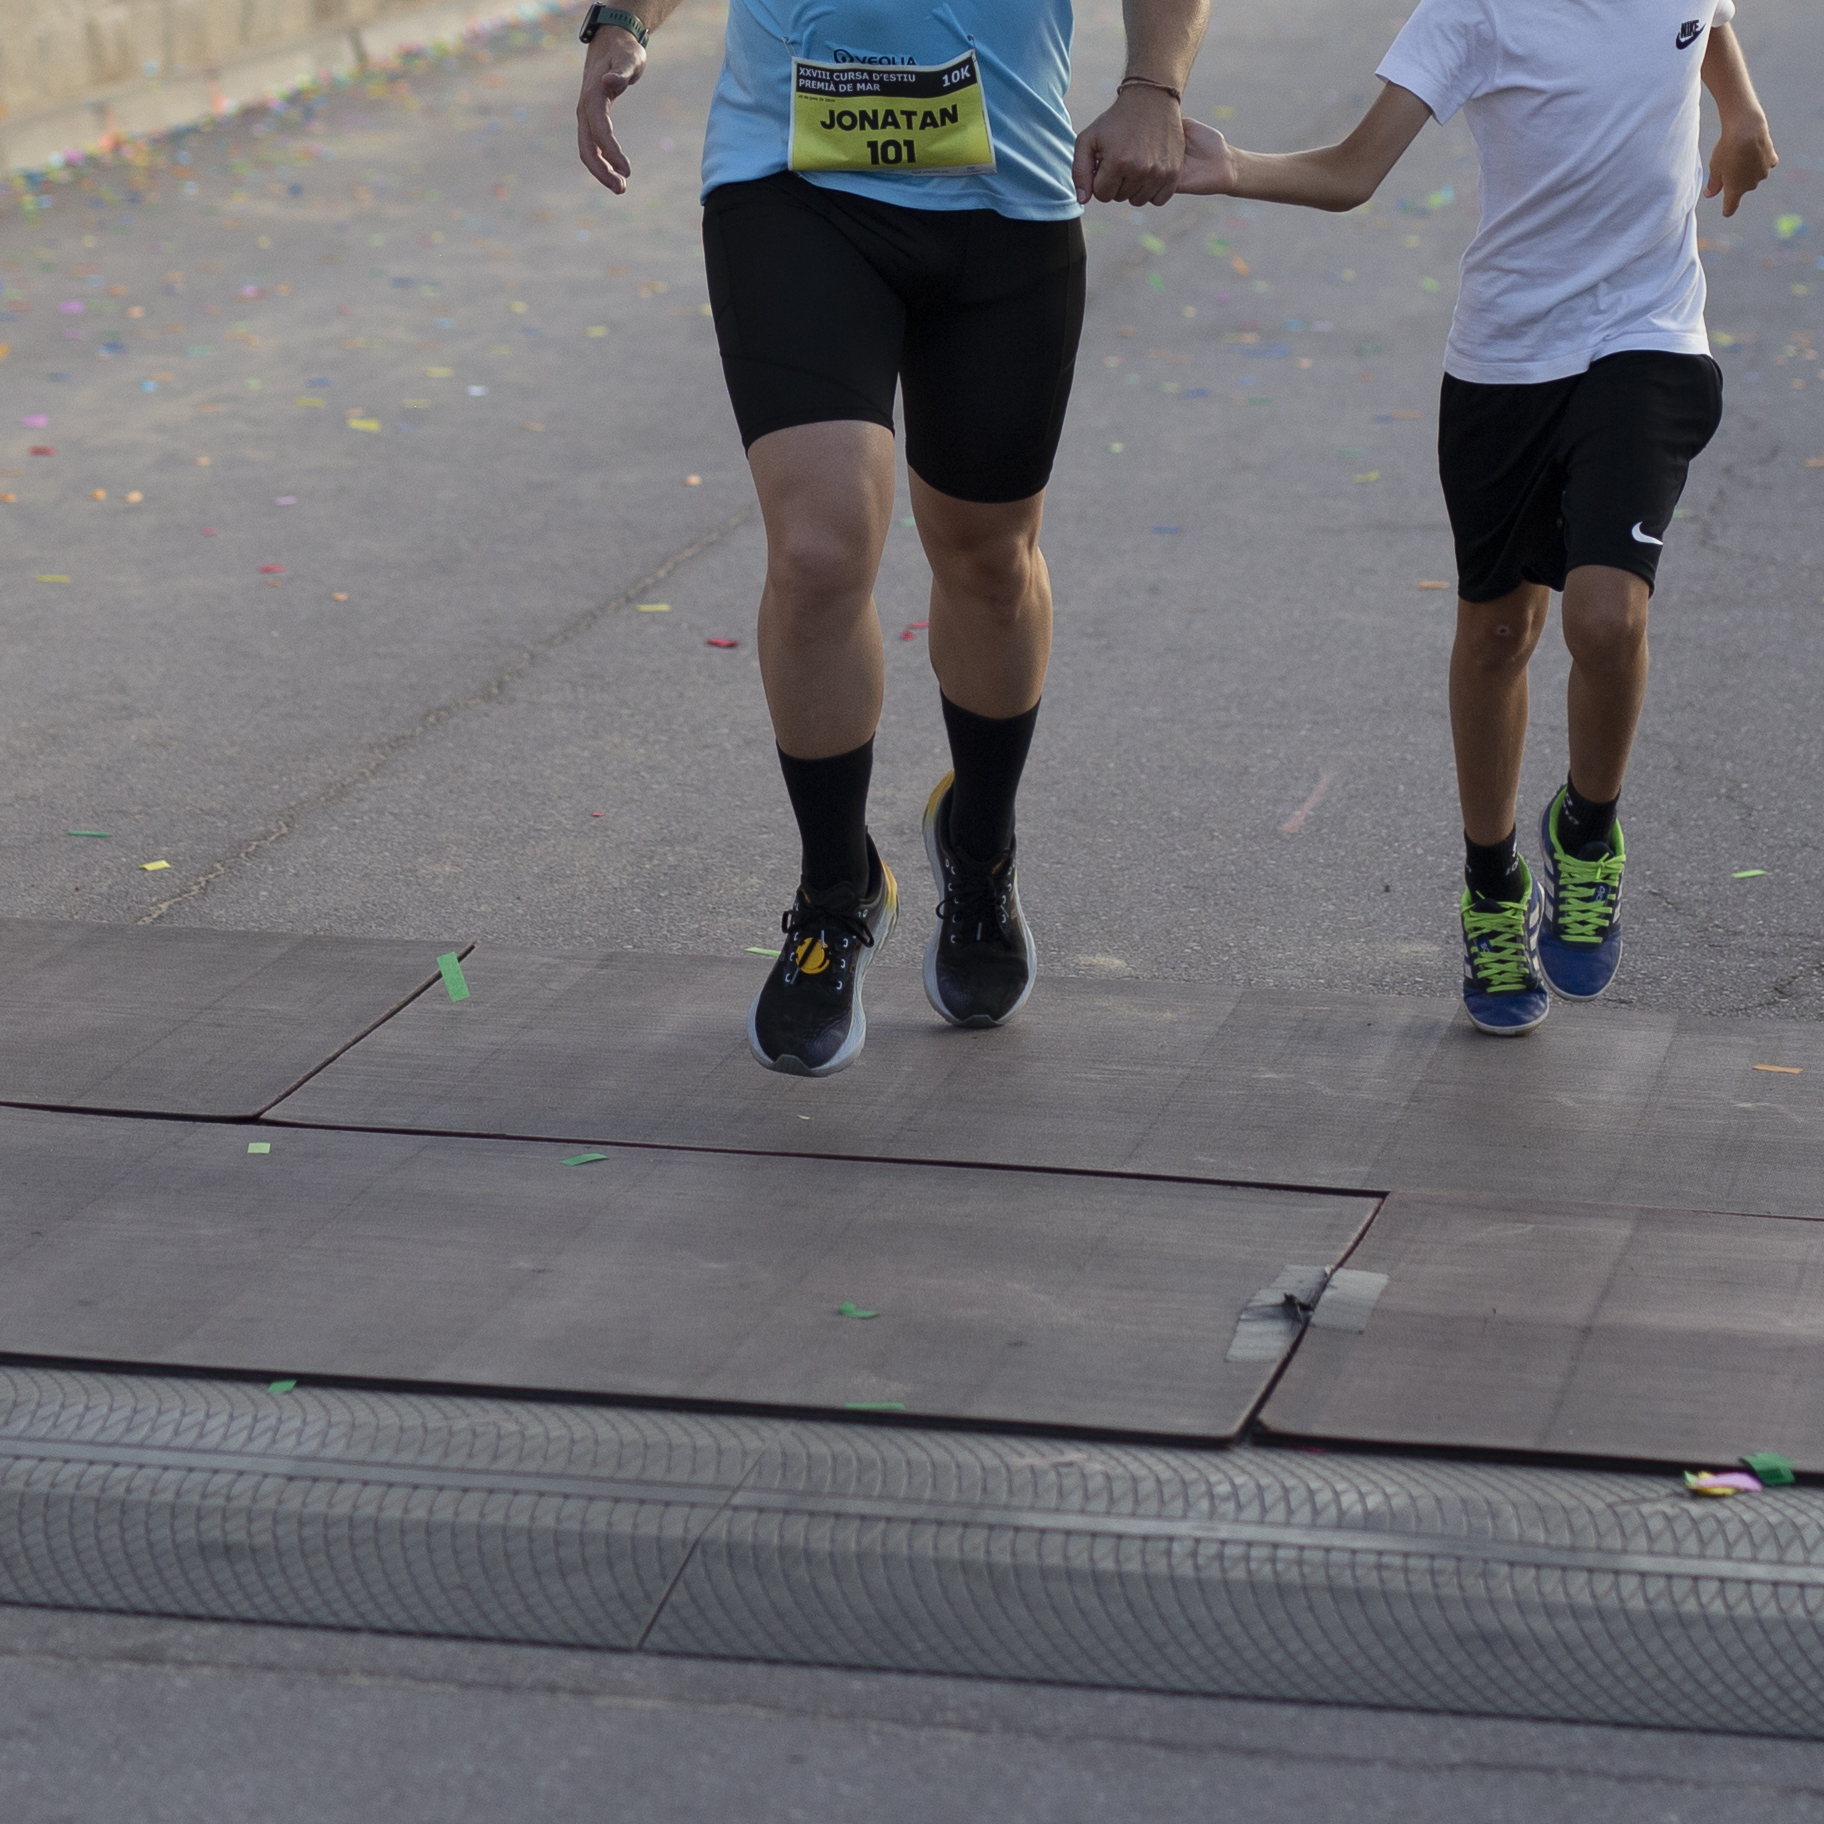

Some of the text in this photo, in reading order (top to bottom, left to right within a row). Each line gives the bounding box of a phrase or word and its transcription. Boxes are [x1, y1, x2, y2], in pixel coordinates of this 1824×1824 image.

[798, 66, 916, 83] XXVIII CURSA D'ESTIU
[798, 78, 881, 93] PREMIÀ DE MAR
[941, 65, 971, 87] 10K
[819, 103, 959, 132] JONATAN
[866, 139, 916, 166] 101
